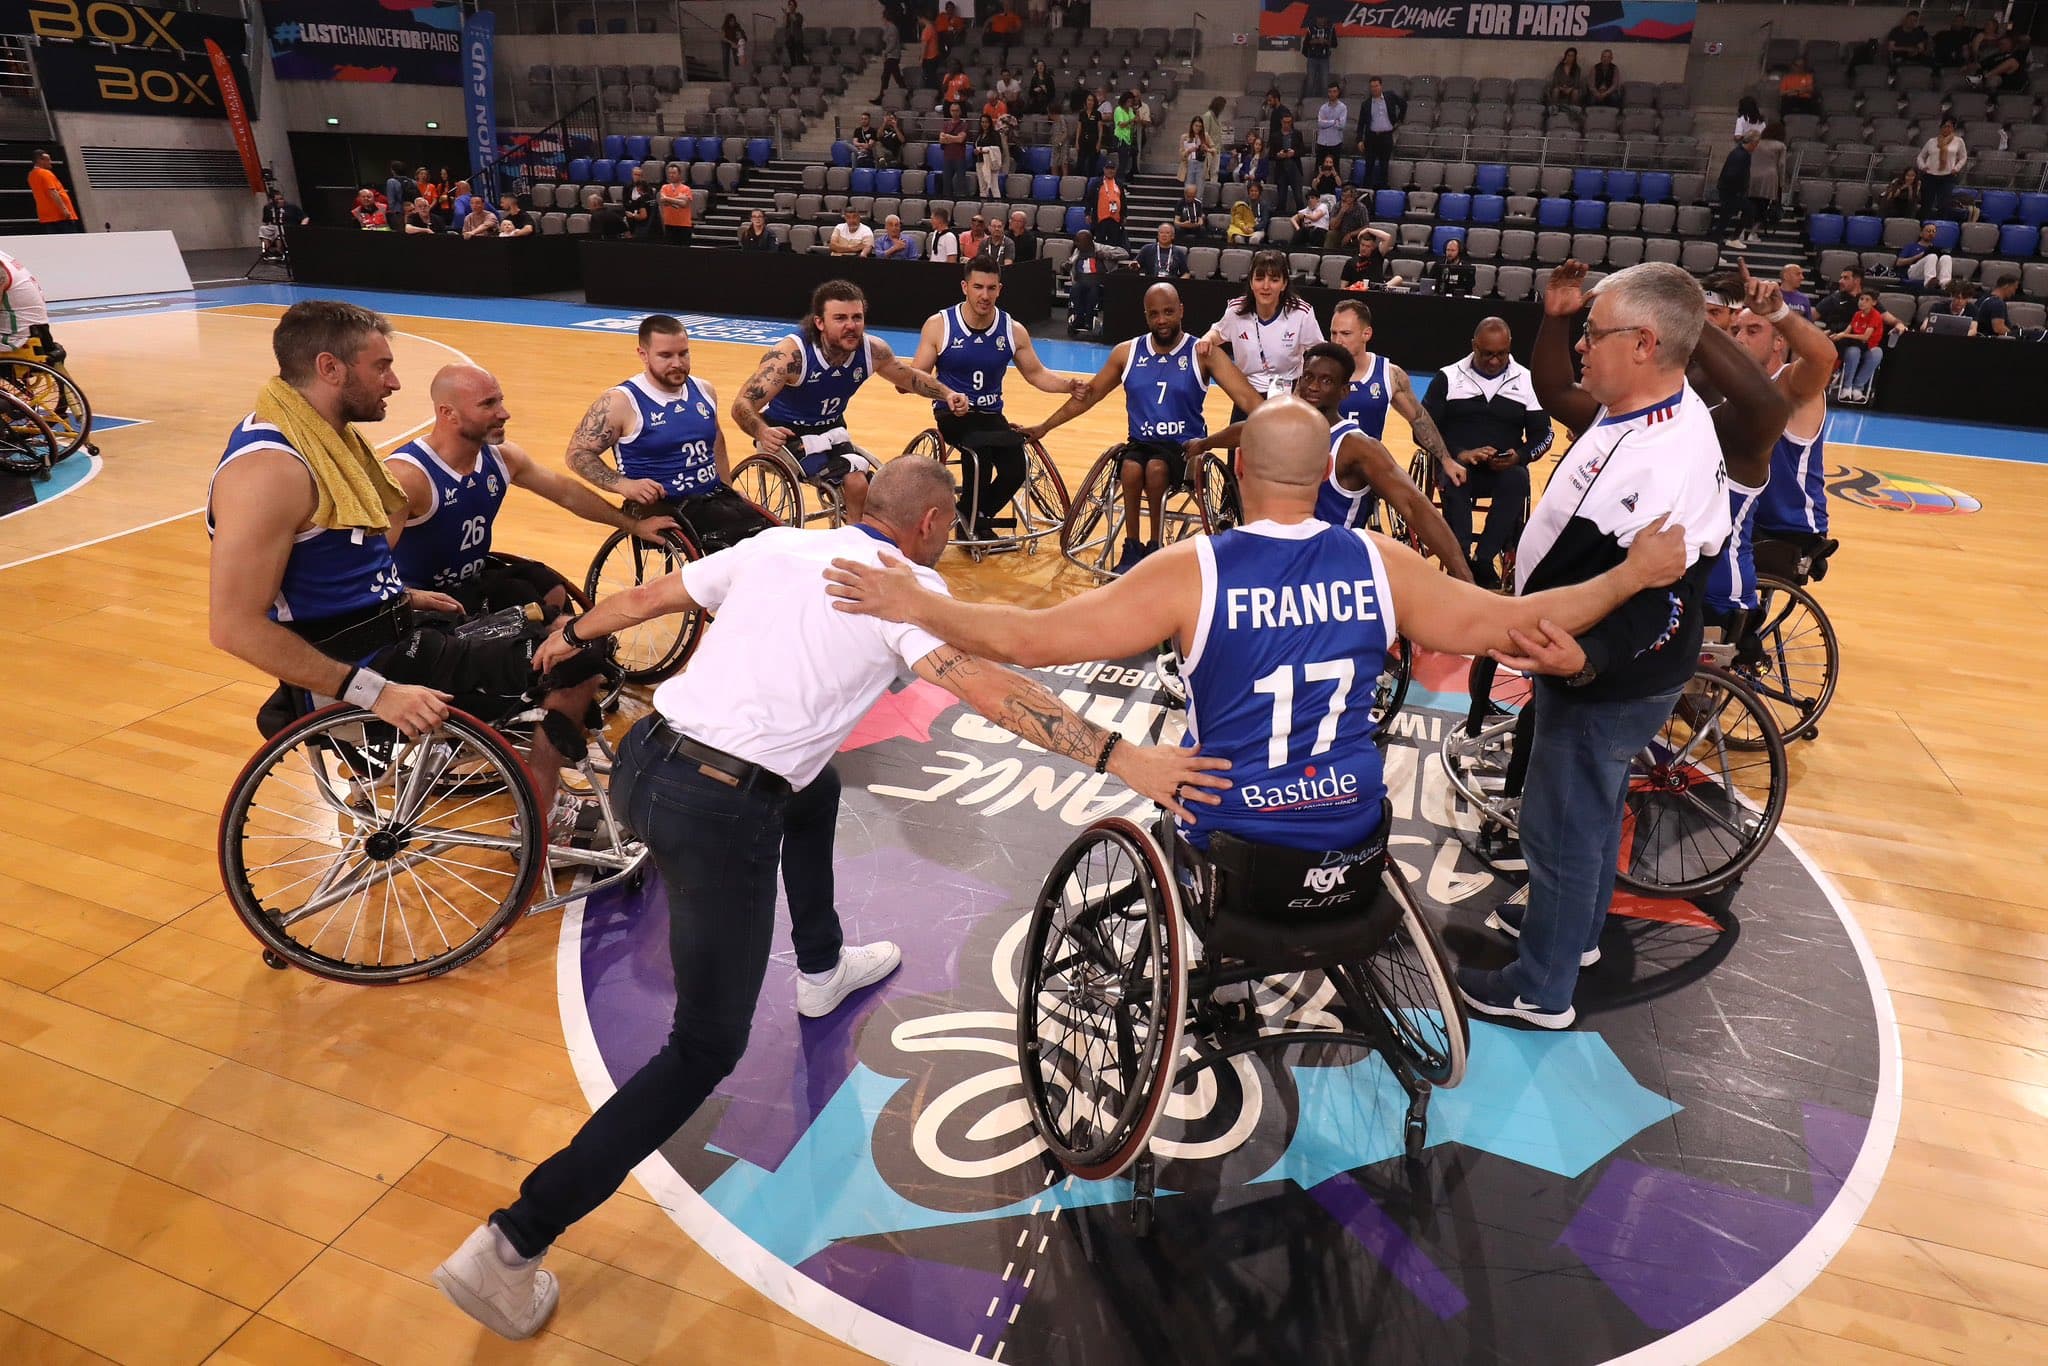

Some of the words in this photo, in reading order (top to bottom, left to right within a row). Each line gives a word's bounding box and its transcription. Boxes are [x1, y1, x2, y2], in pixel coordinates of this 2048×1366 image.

[28, 0, 185, 50] BOX
[274, 21, 460, 53] #LASTCHANCEFORPARIS
[1342, 3, 1393, 28] LAST
[1391, 4, 1463, 29] CHANCE
[1466, 3, 1513, 35] FOR
[1516, 4, 1590, 36] PARIS
[95, 65, 214, 105] BOX
[471, 42, 486, 98] SUD
[973, 370, 984, 390] 9
[1156, 382, 1168, 404] 7
[821, 397, 841, 416] 12
[682, 440, 709, 468] 29
[460, 515, 486, 552] 26
[1227, 580, 1378, 630] FRANCE
[1254, 658, 1355, 769] 17
[1241, 765, 1358, 808] Bastide
[1287, 890, 1357, 908] ELITE
